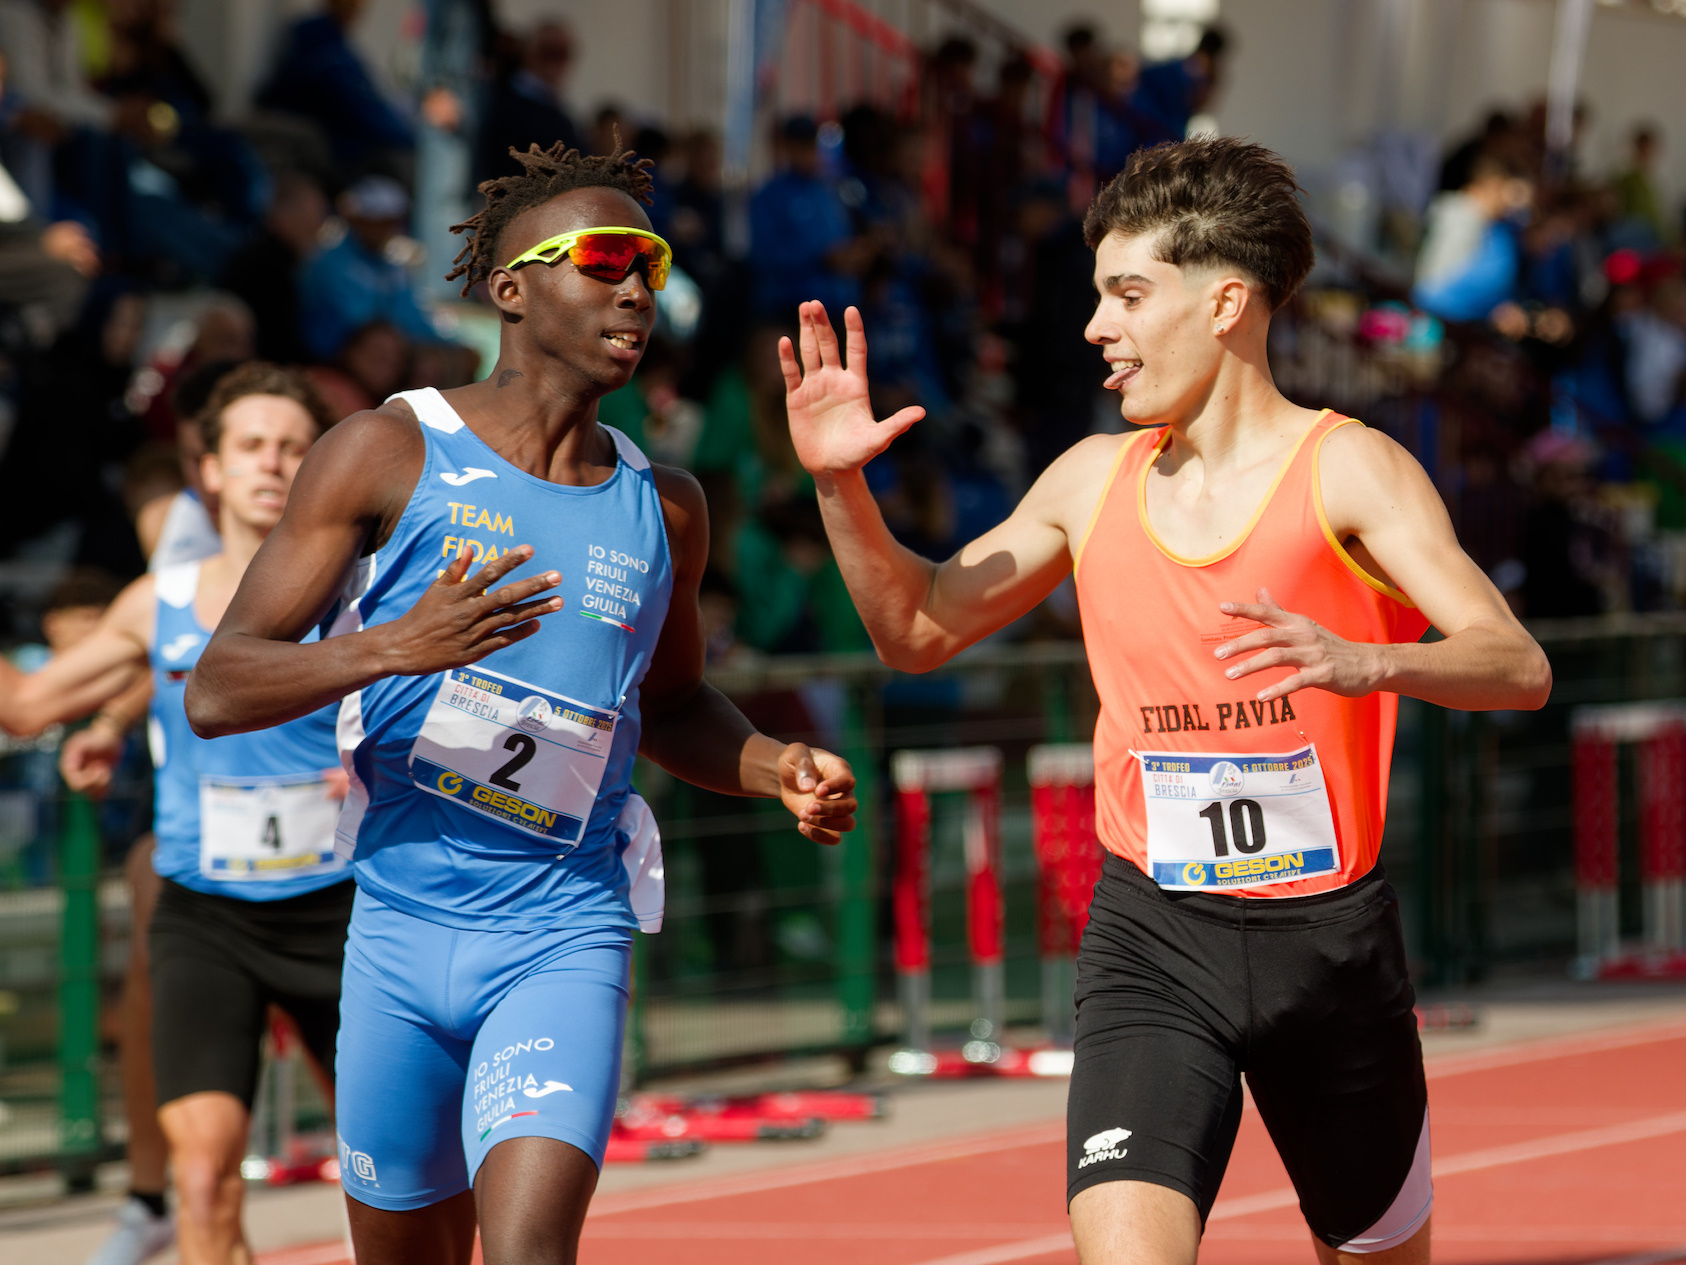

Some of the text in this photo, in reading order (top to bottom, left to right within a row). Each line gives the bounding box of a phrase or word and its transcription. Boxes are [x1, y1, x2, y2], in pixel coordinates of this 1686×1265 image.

[447, 502, 514, 536] TEAM
[587, 560, 627, 582] FRIULI
[588, 544, 649, 574] IO SONO
[585, 576, 641, 606] VENEZIA
[582, 594, 627, 619] GIULIA
[471, 676, 503, 695] TROFEO
[480, 693, 490, 703] DI
[450, 693, 499, 720] BRESCIA
[554, 705, 562, 716] 5
[562, 708, 597, 728] OTTOBRE
[1140, 696, 1296, 733] FIDAL PAVIA
[488, 733, 537, 792] 2
[1162, 761, 1190, 773] TROFEO
[1242, 756, 1314, 773] 5 OTTOBRE 2025
[1154, 784, 1197, 798] BRESCIA
[1175, 775, 1183, 784] DI
[472, 786, 557, 828] GESON
[261, 815, 281, 849] 4
[1199, 798, 1267, 857] 10
[1214, 852, 1304, 878] GESON
[1217, 875, 1261, 886] SOLUZIONI
[474, 1037, 554, 1082] IO SONO
[474, 1062, 511, 1100] FRIULI
[474, 1073, 538, 1115] VENEZIA
[477, 1096, 516, 1132] GIULIA
[1078, 1148, 1128, 1169] KARHU
